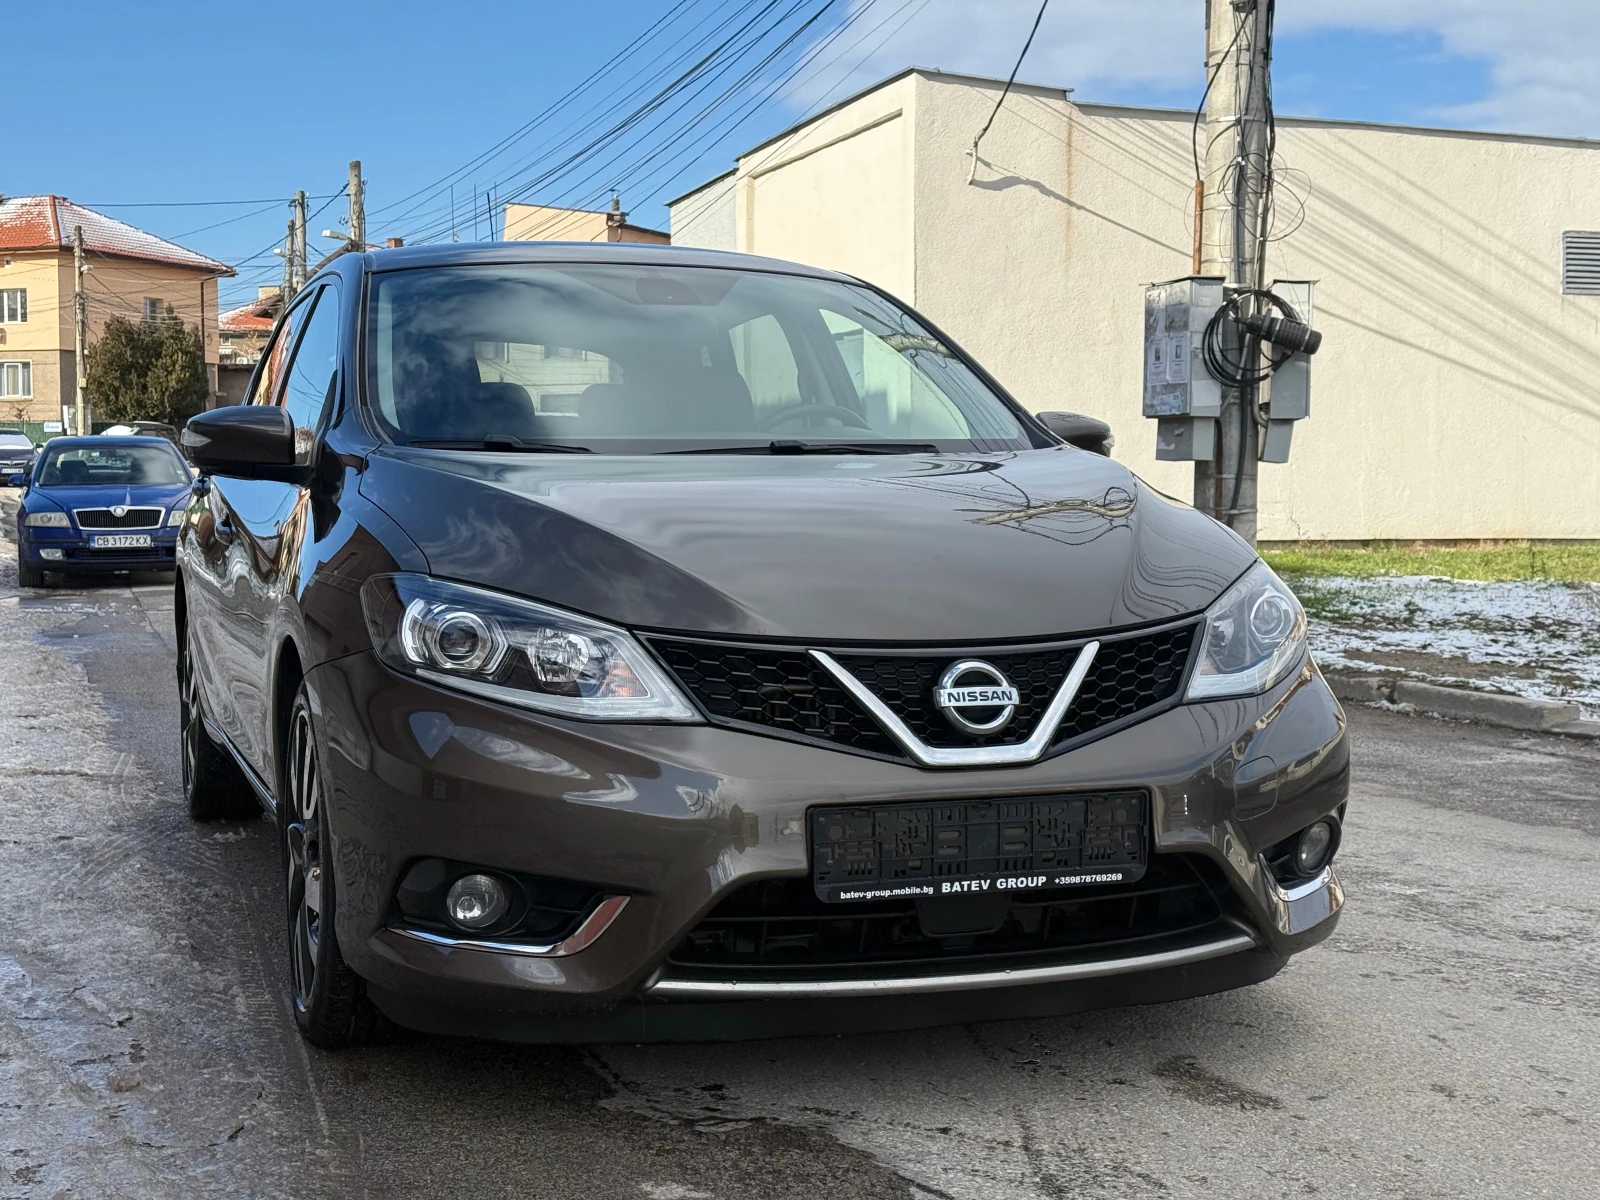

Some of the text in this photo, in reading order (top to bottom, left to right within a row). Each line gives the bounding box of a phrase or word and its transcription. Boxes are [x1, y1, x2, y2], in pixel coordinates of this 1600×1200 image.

[947, 690, 1013, 703] NISSAN
[840, 873, 1123, 899] batev-group.mobile.bg BATEV GROUP +359878769269
